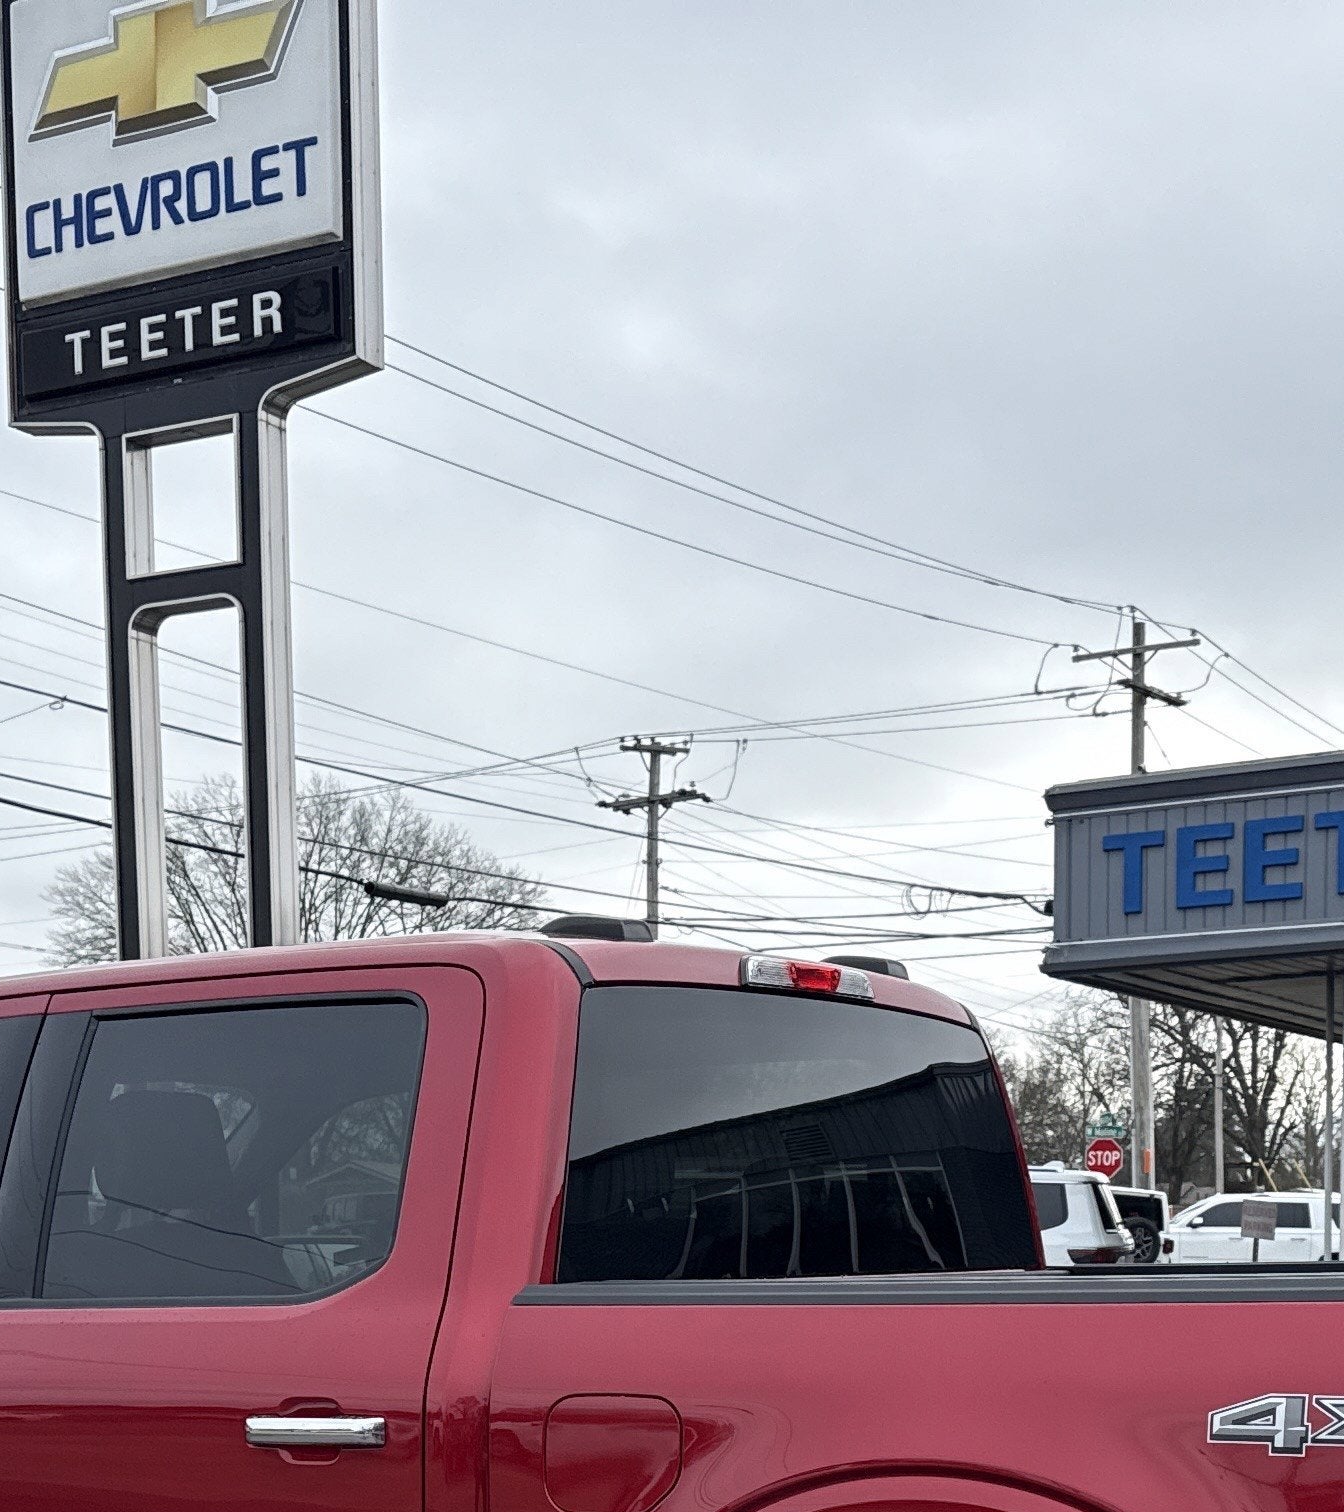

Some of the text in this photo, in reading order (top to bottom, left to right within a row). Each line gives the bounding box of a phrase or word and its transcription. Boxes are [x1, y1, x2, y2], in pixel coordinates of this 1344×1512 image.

[25, 136, 318, 259] CHEVROLET
[64, 290, 283, 375] TEETER
[1087, 1150, 1121, 1167] STOP
